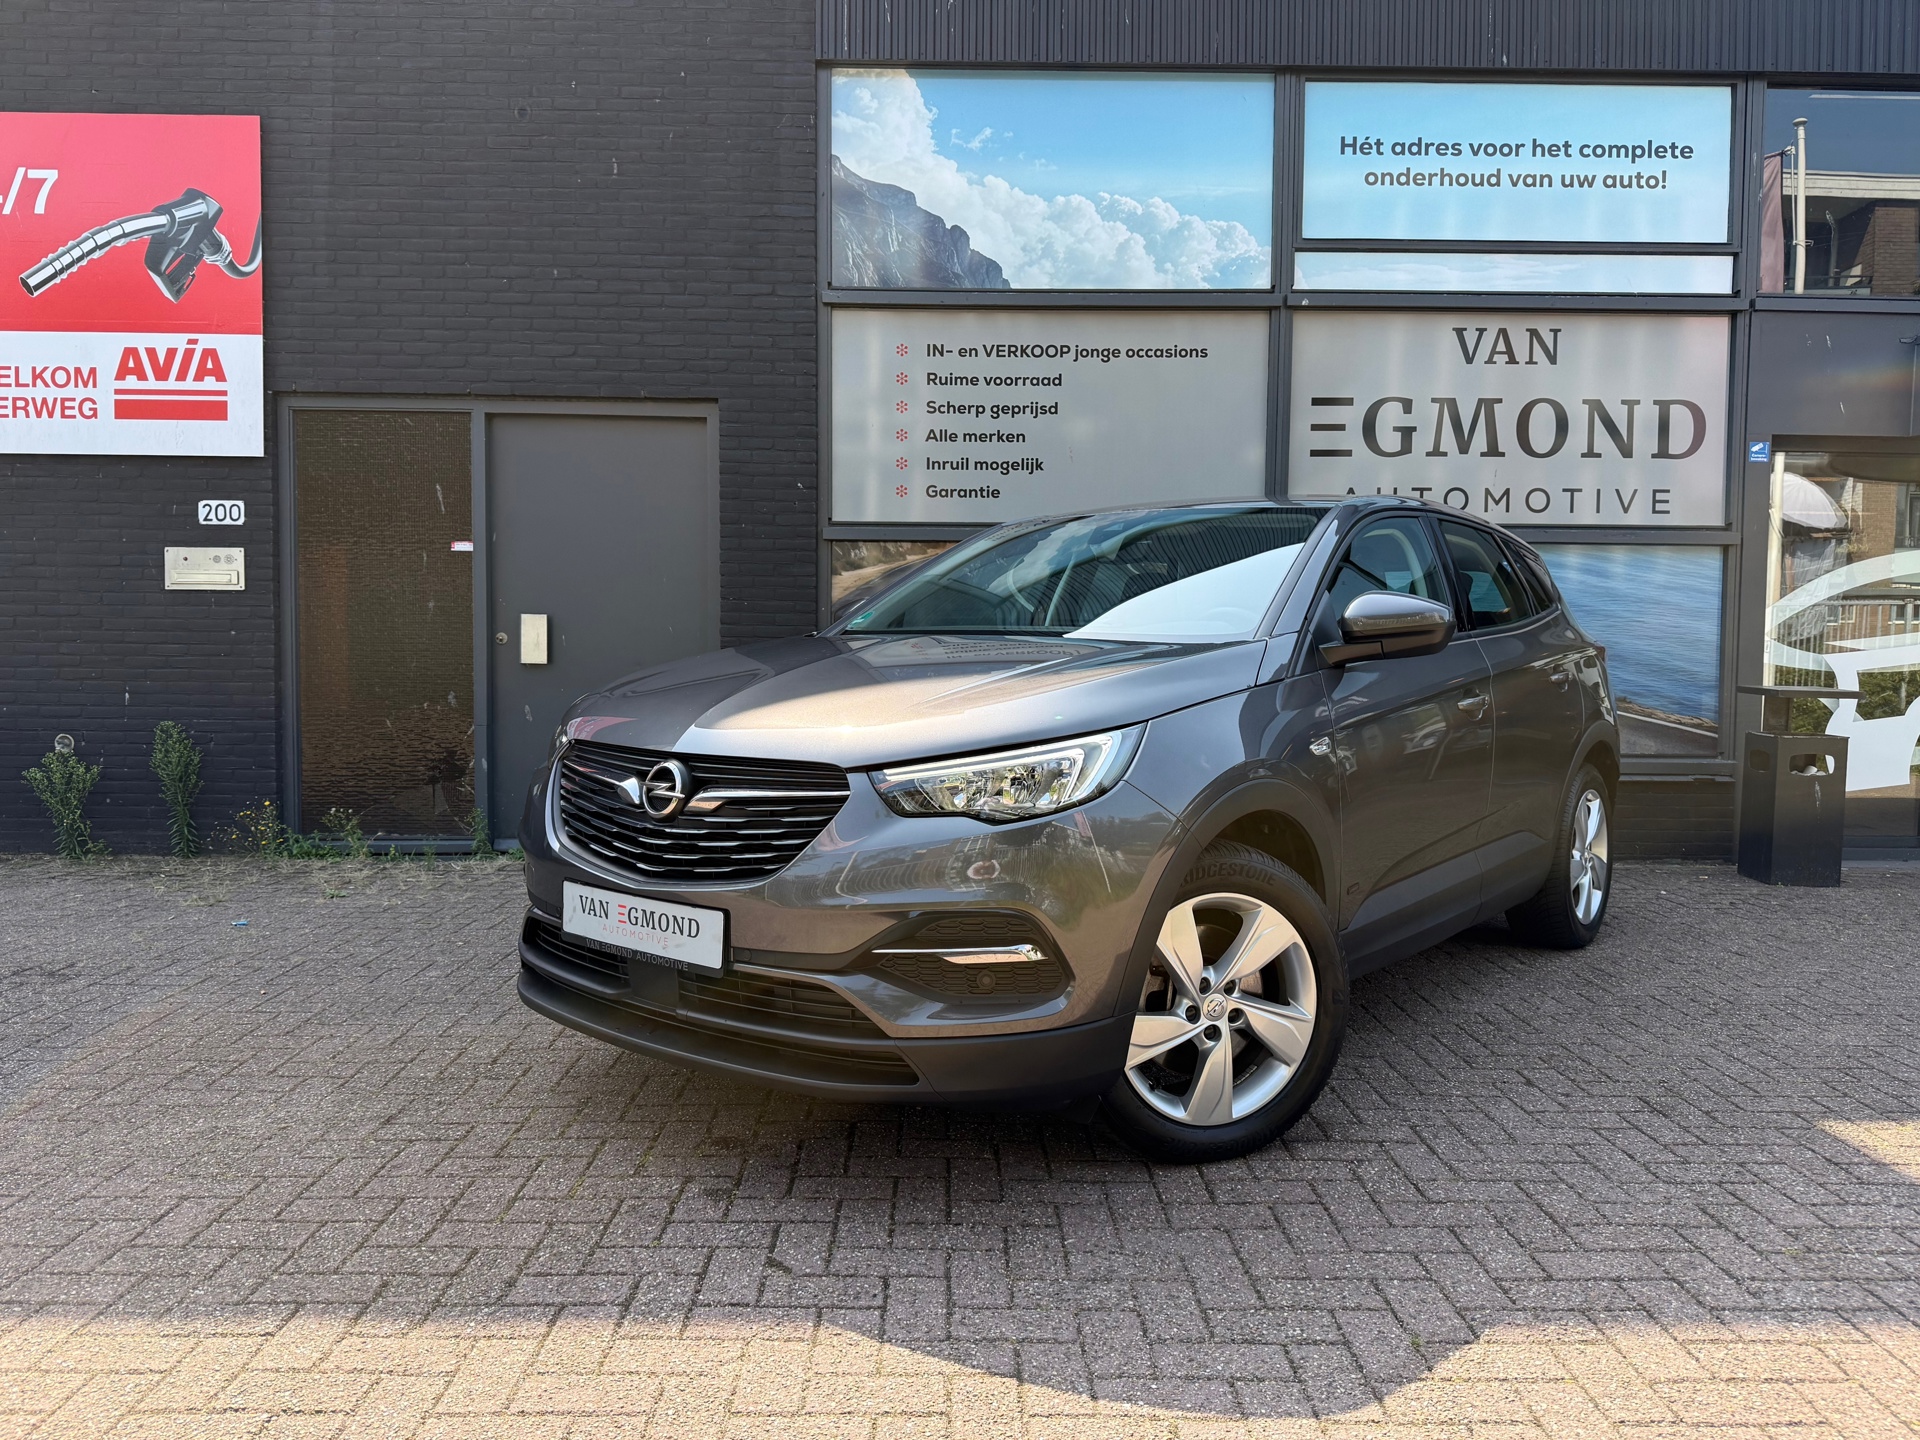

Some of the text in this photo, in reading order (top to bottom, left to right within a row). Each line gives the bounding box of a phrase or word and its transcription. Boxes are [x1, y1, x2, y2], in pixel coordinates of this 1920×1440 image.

[1341, 135, 1694, 165] Hét adres voor het complete
[1364, 166, 1667, 190] onderhoud van uw auto!
[0, 166, 59, 215] /7
[926, 343, 1209, 363] IN- en VERKOOP jonge occasions
[1451, 327, 1562, 366] VAN
[926, 372, 1063, 387] Ruime voorraad
[926, 400, 1059, 419] Scherp geprijsd
[925, 428, 1026, 443] Alle merken
[1310, 396, 1707, 460] EGMOND
[926, 456, 1045, 475] Inruil mogelijk
[926, 484, 1001, 499] Garantie
[202, 503, 242, 522] 200
[579, 894, 700, 939] VAN EGMOND
[602, 923, 669, 948] AUTOMOTIVE
[586, 939, 600, 950] VAN
[636, 952, 689, 971] AUTOMOTIVE
